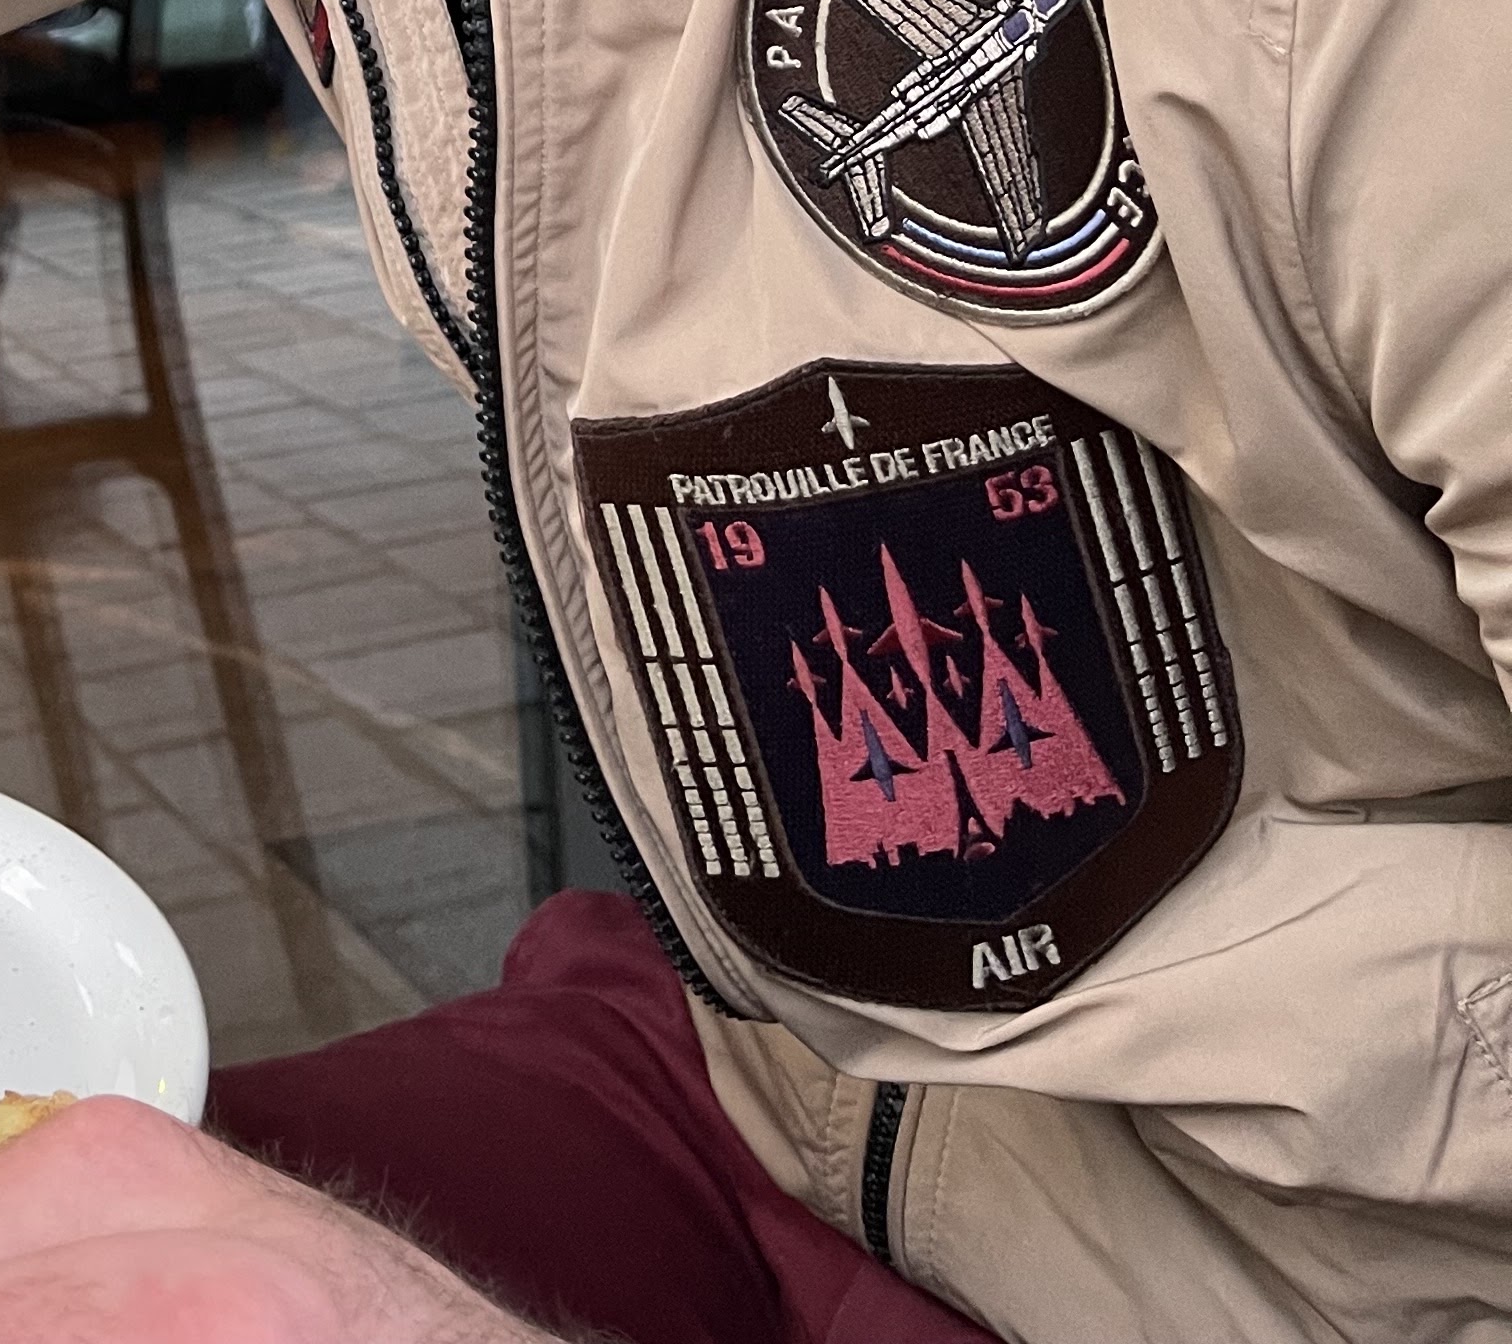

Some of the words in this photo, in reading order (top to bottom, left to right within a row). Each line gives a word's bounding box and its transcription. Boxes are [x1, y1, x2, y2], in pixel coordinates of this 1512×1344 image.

[669, 457, 869, 505] PATROUILLE
[871, 447, 920, 484] DE
[921, 414, 1057, 475] FRANCE
[697, 521, 766, 571] 19
[984, 464, 1059, 521] 53
[972, 923, 1062, 990] AIR
